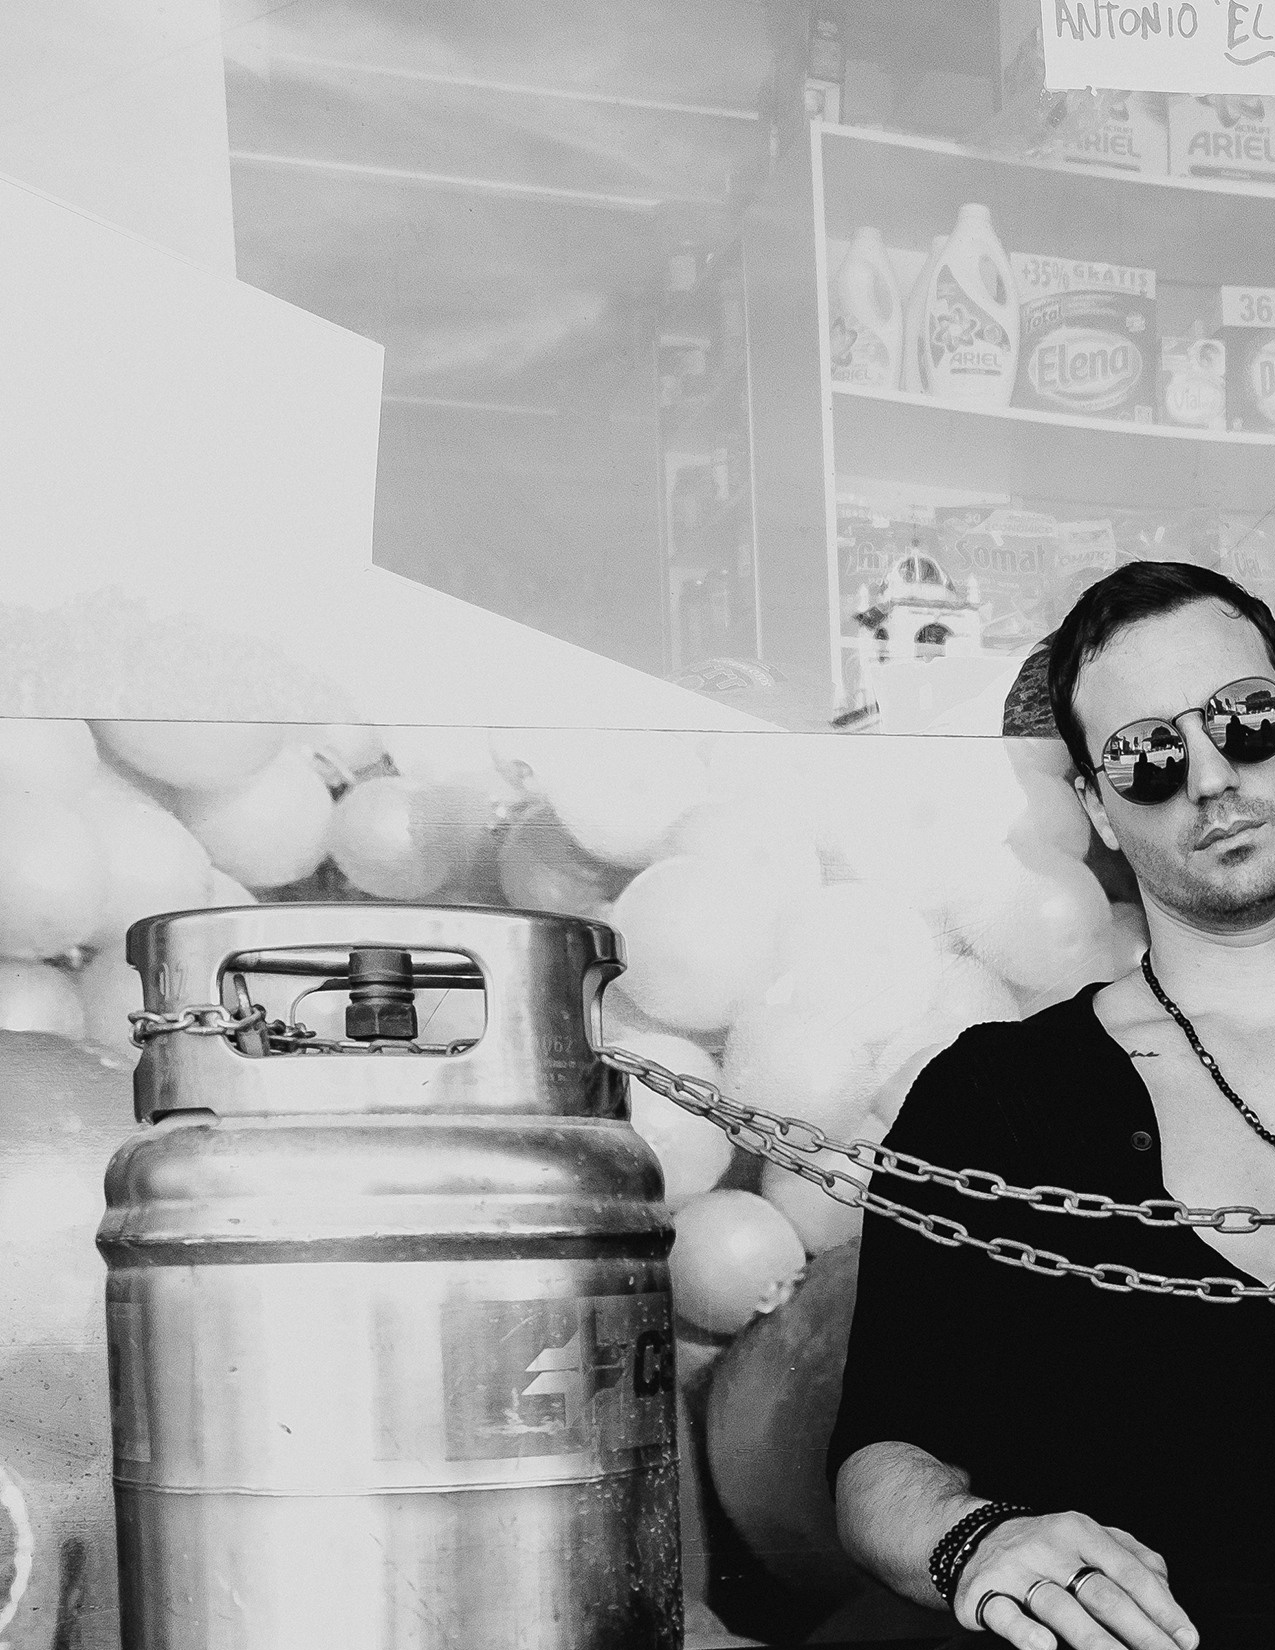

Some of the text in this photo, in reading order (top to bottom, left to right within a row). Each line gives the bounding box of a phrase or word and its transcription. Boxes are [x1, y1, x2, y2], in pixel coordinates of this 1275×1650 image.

[1055, 0, 1198, 41] ANTONIO
[1226, 0, 1274, 50] EL
[1239, 294, 1273, 322] 36
[949, 353, 1002, 368] ARIEL
[1037, 343, 1129, 389] Elena
[956, 540, 1045, 572] Somat
